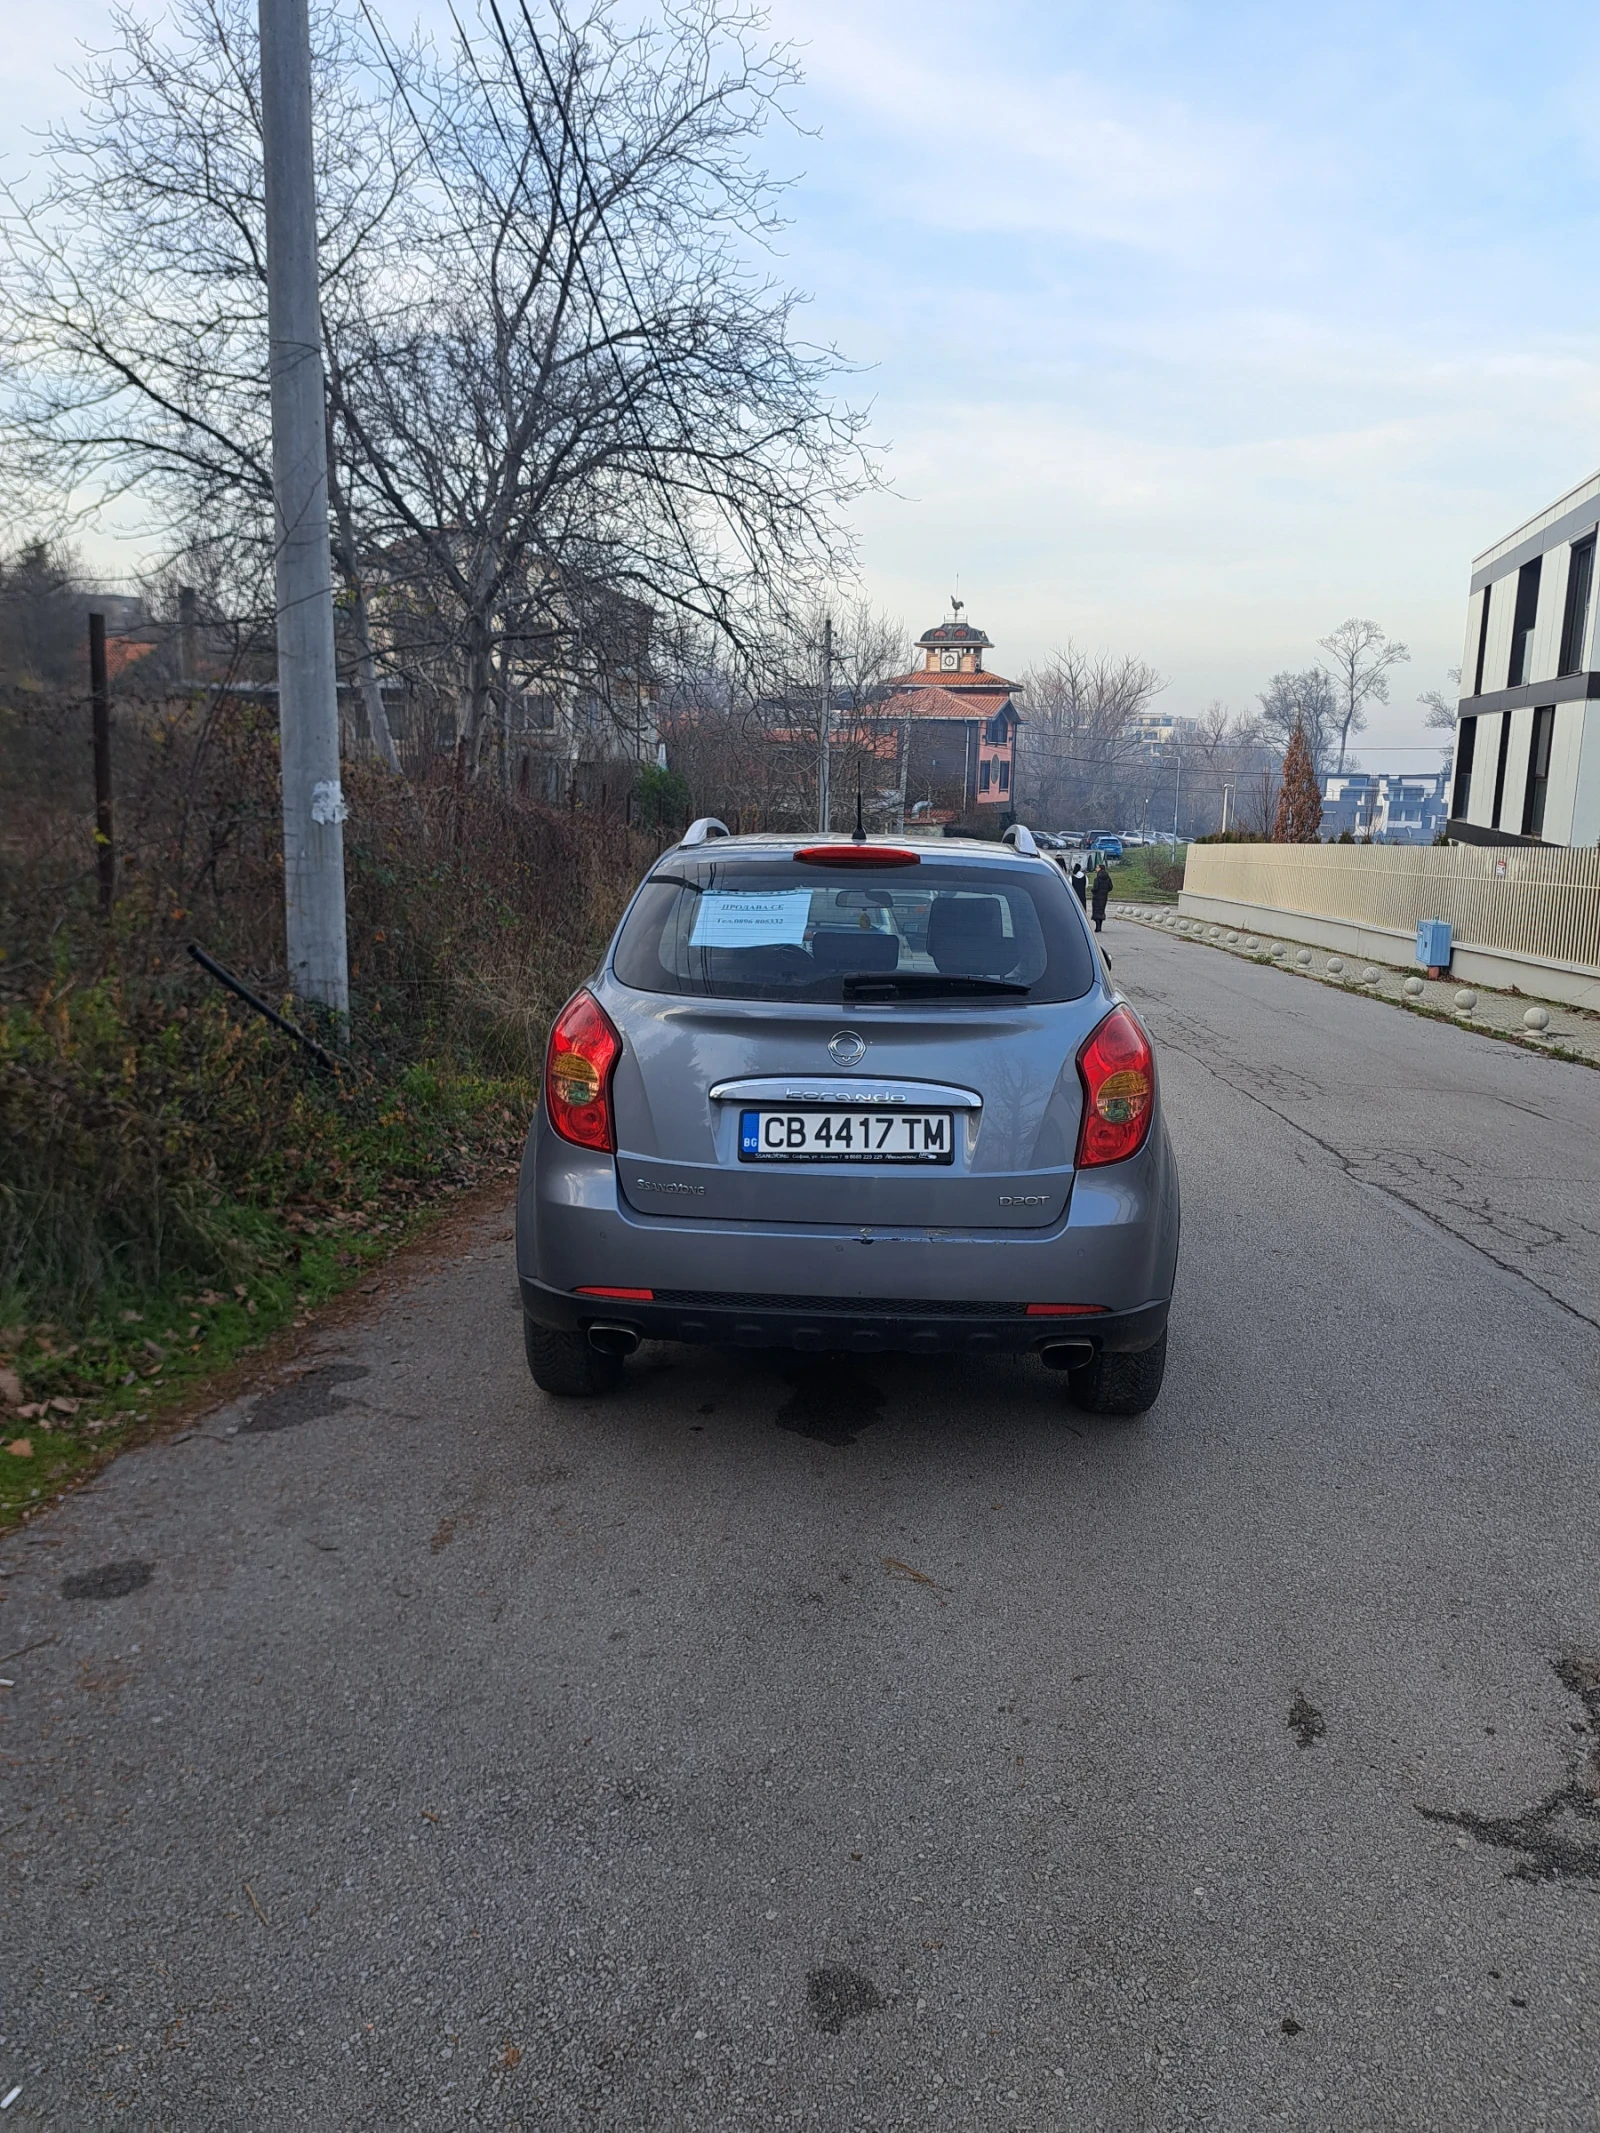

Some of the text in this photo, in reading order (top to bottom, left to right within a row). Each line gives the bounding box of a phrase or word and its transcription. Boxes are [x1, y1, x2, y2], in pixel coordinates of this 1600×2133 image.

[721, 903, 784, 911] ПРОДАВА СЕ
[764, 1116, 945, 1151] CB 4417 TM
[743, 1137, 758, 1148] BG
[999, 1195, 1051, 1206] D20T
